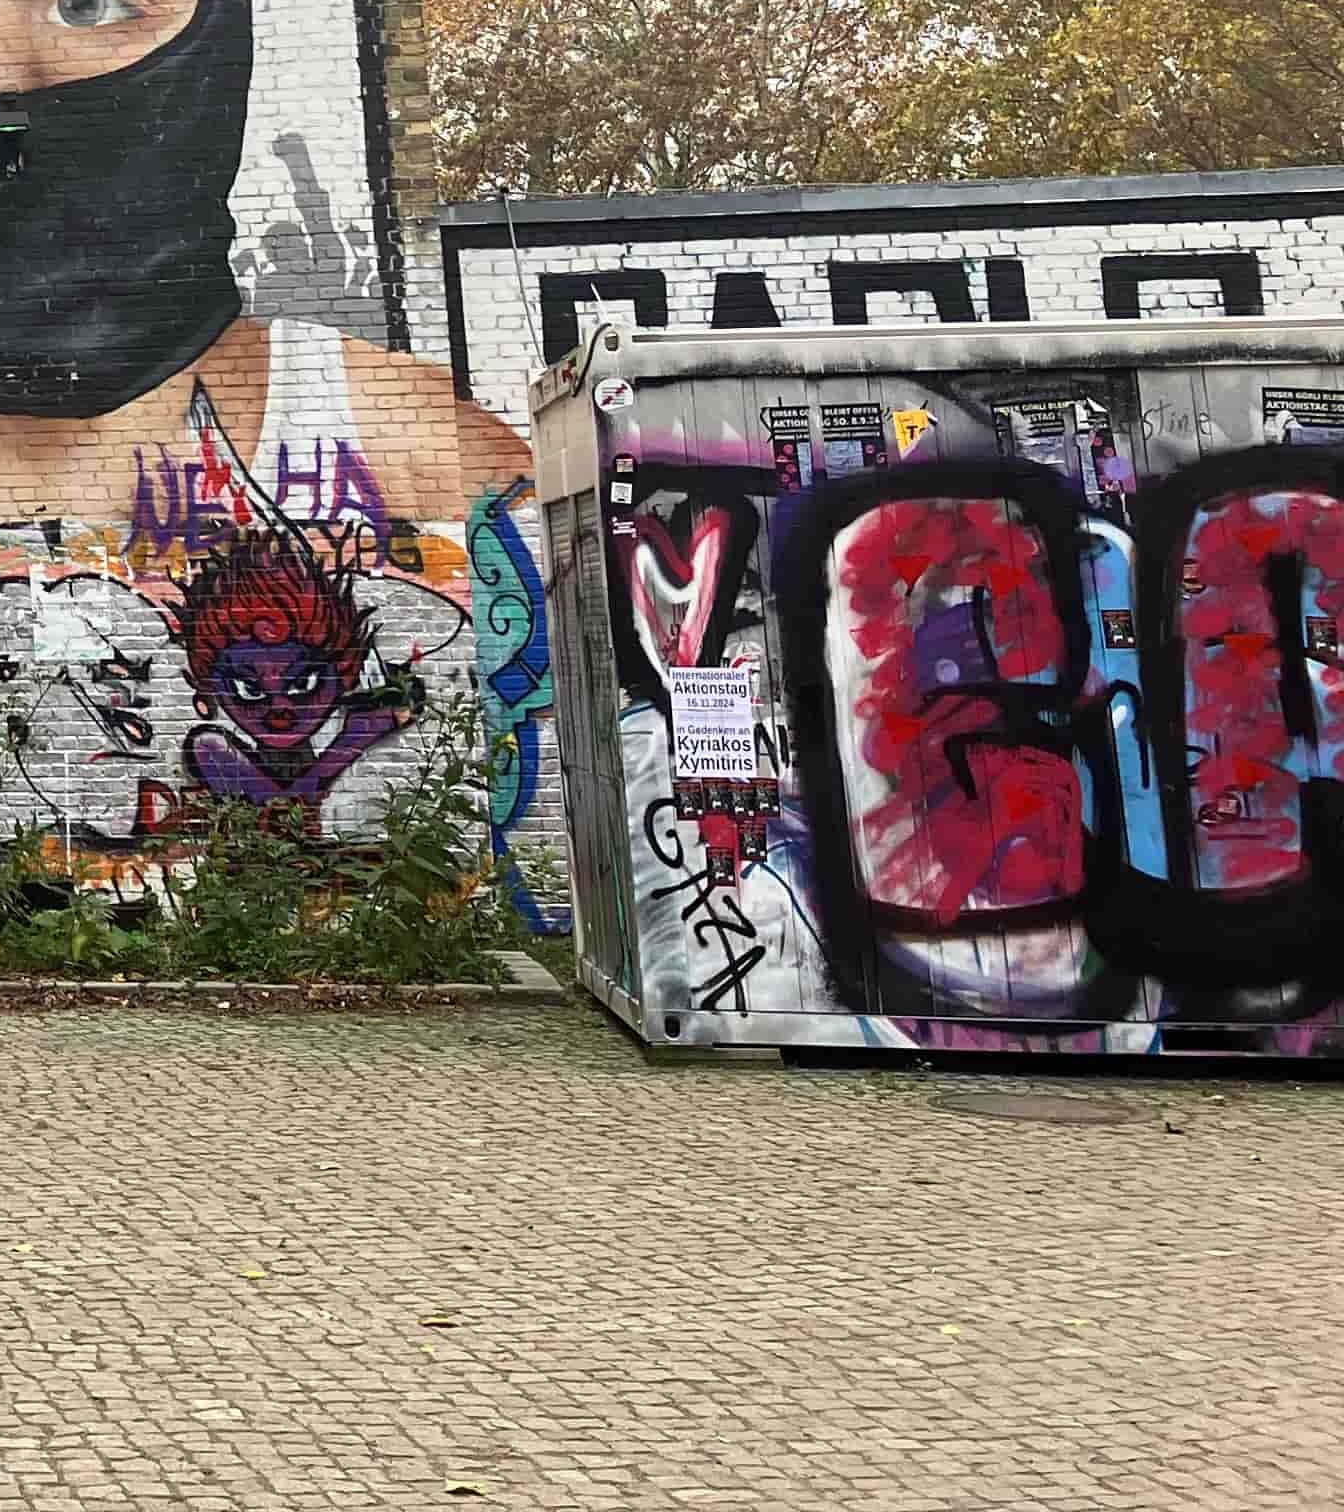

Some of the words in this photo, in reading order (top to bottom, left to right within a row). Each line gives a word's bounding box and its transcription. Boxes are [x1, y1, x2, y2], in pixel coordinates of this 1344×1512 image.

[672, 670, 746, 682] Internationaler
[673, 681, 748, 699] Aktionstag
[687, 724, 736, 736] Gedenken
[739, 727, 752, 735] an
[677, 735, 752, 755] Kyriakos
[679, 754, 753, 774] Xymitiris
[643, 797, 767, 1019] GAZA
